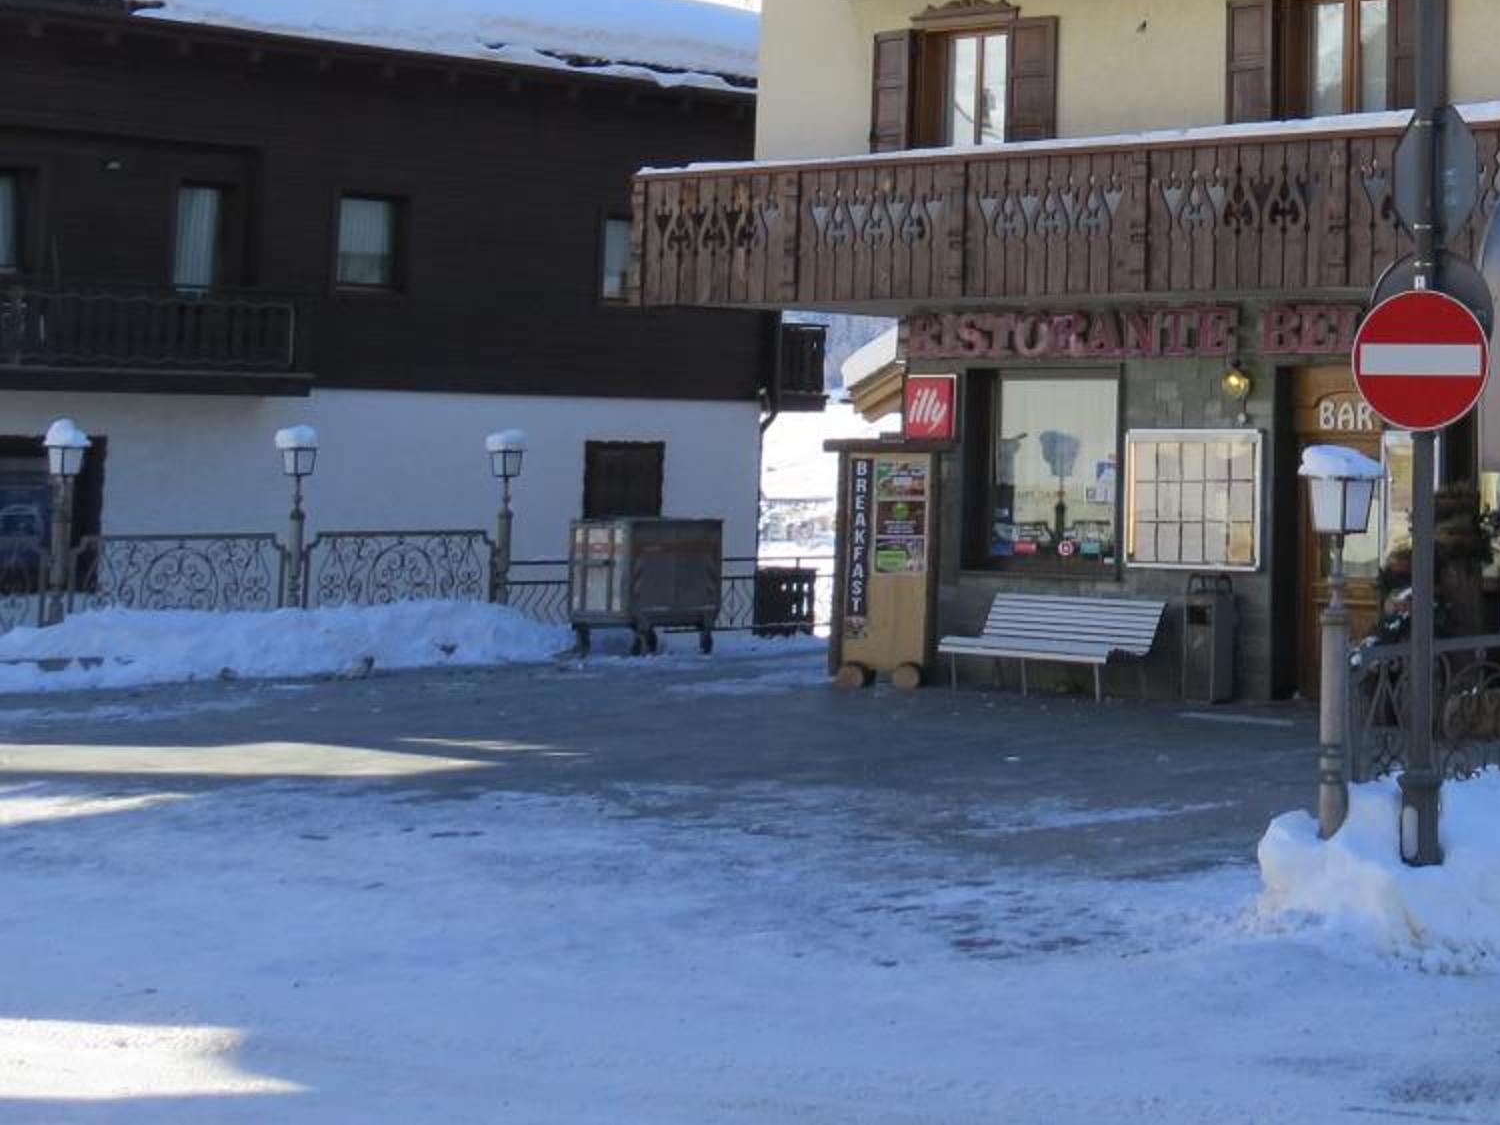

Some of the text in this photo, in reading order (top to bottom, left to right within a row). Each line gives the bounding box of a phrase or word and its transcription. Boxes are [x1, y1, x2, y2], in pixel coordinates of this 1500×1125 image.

[907, 306, 1238, 357] RISTORANTE
[909, 388, 948, 434] illy
[1319, 400, 1373, 430] BAR
[852, 461, 867, 612] BREAKFAST
